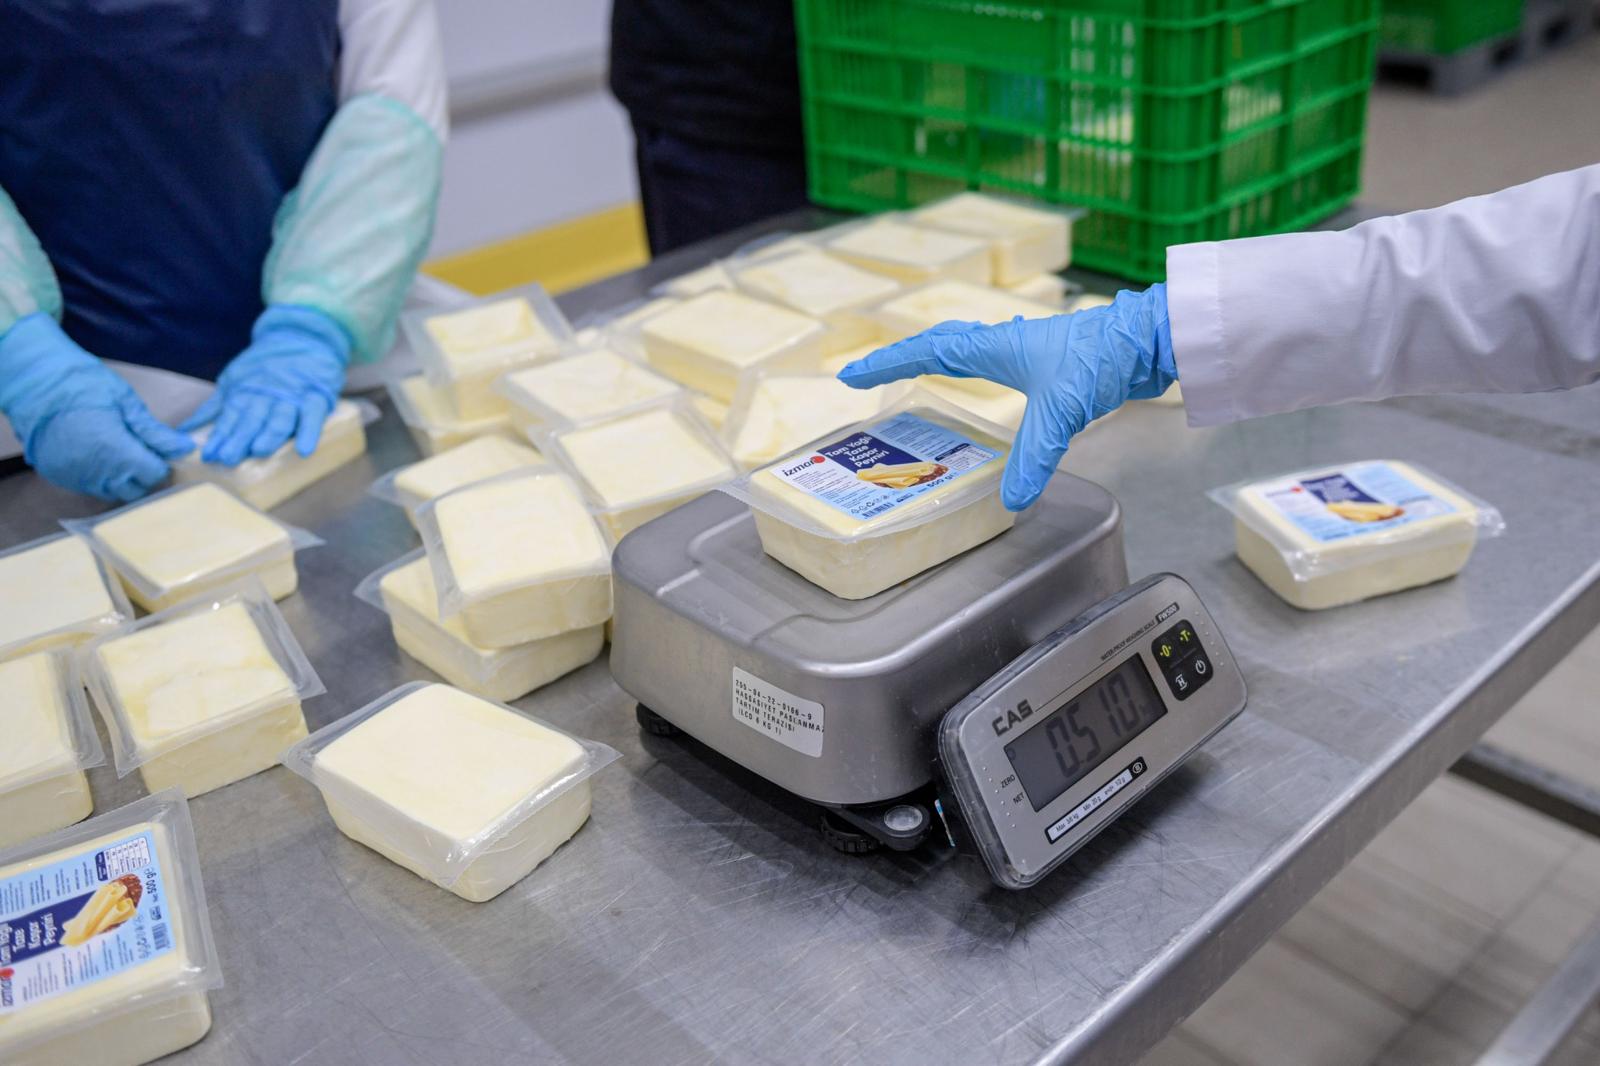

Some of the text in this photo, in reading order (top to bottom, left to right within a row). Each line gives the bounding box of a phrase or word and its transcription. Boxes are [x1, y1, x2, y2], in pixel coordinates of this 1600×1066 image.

[825, 446, 849, 457] Tam
[844, 445, 869, 456] Taze
[849, 448, 879, 462] Kaşar
[854, 450, 890, 468] Peyniri
[992, 699, 1033, 736] CAS
[1001, 774, 1015, 788] ZERO
[1012, 792, 1025, 804] NET
